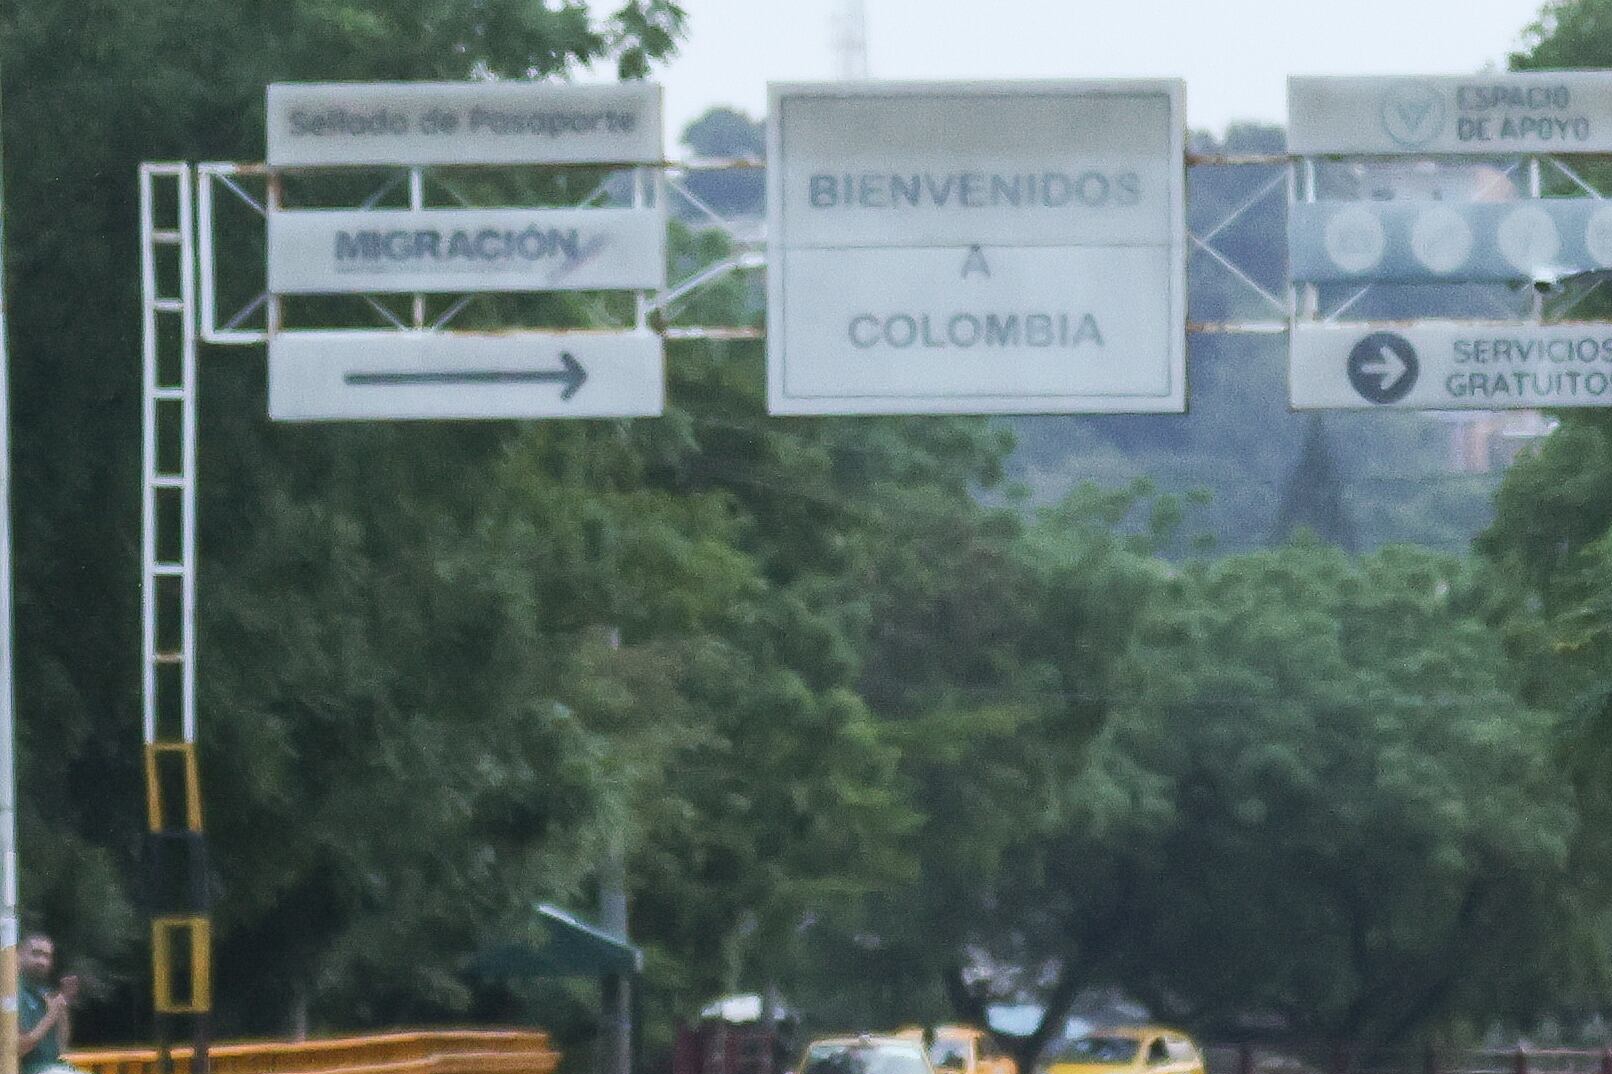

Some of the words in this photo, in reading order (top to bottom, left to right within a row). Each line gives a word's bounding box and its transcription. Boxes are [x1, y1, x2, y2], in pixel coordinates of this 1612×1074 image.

[1456, 85, 1570, 110] ESPACIO
[288, 106, 409, 136] Sellado
[419, 107, 458, 136] de
[468, 106, 636, 138] Pasaporte
[1456, 117, 1491, 141] DE
[1500, 116, 1591, 141] APOYO
[809, 170, 1144, 209] BIENVENIDOS
[334, 223, 579, 262] MIGRACIÓN
[960, 244, 991, 280] A
[847, 311, 1105, 350] COLOMBIA
